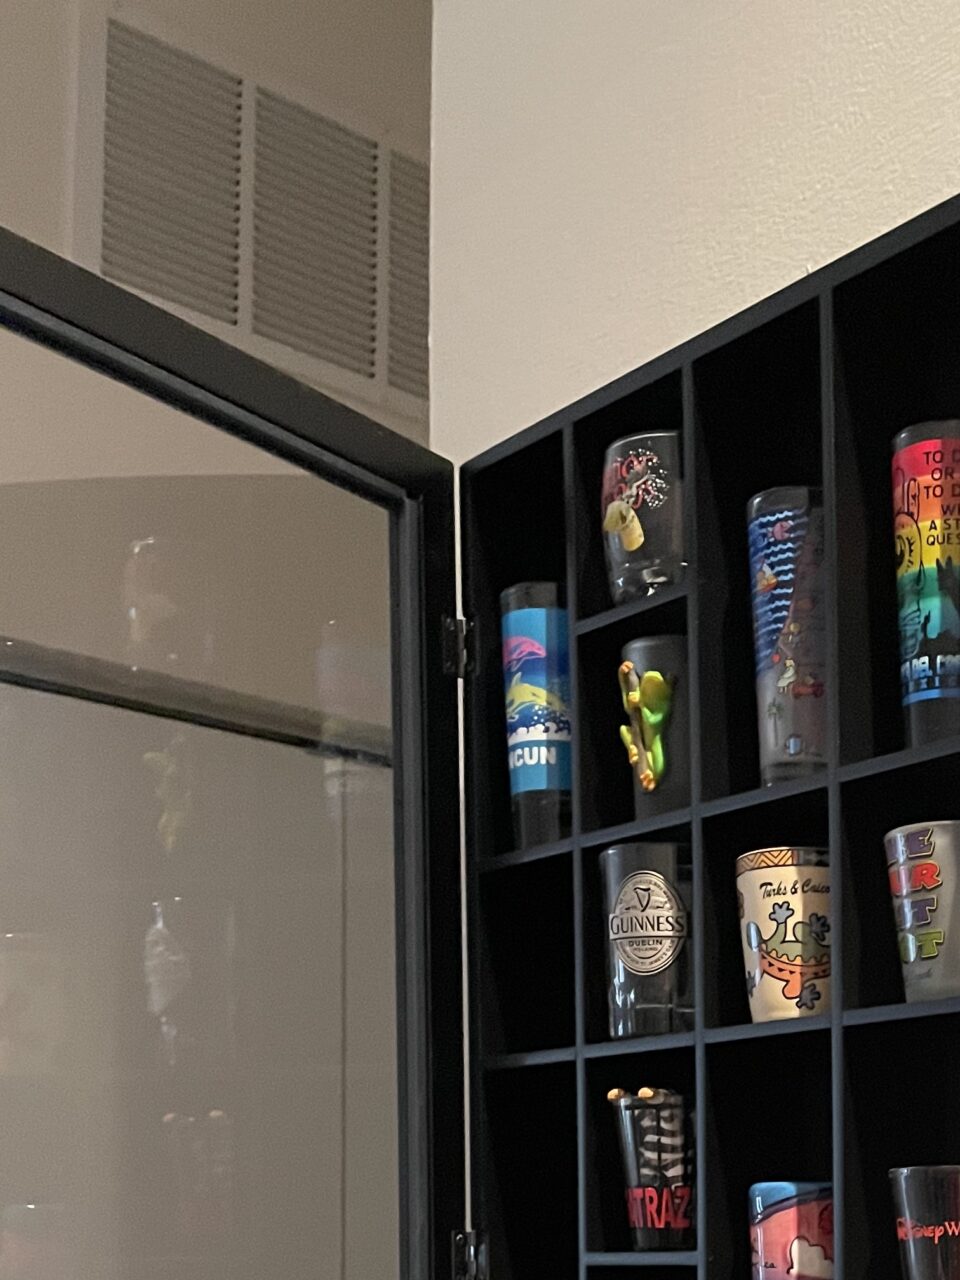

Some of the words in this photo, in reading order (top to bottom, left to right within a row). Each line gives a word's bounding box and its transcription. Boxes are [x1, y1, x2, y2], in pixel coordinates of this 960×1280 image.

[923, 450, 944, 466] TO
[931, 467, 954, 481] OR
[924, 484, 944, 500] TO
[929, 519, 938, 532] A
[759, 881, 788, 900] Turks
[790, 879, 799, 895] &
[610, 915, 685, 935] GUINNESS
[628, 938, 663, 948] DUBLIN
